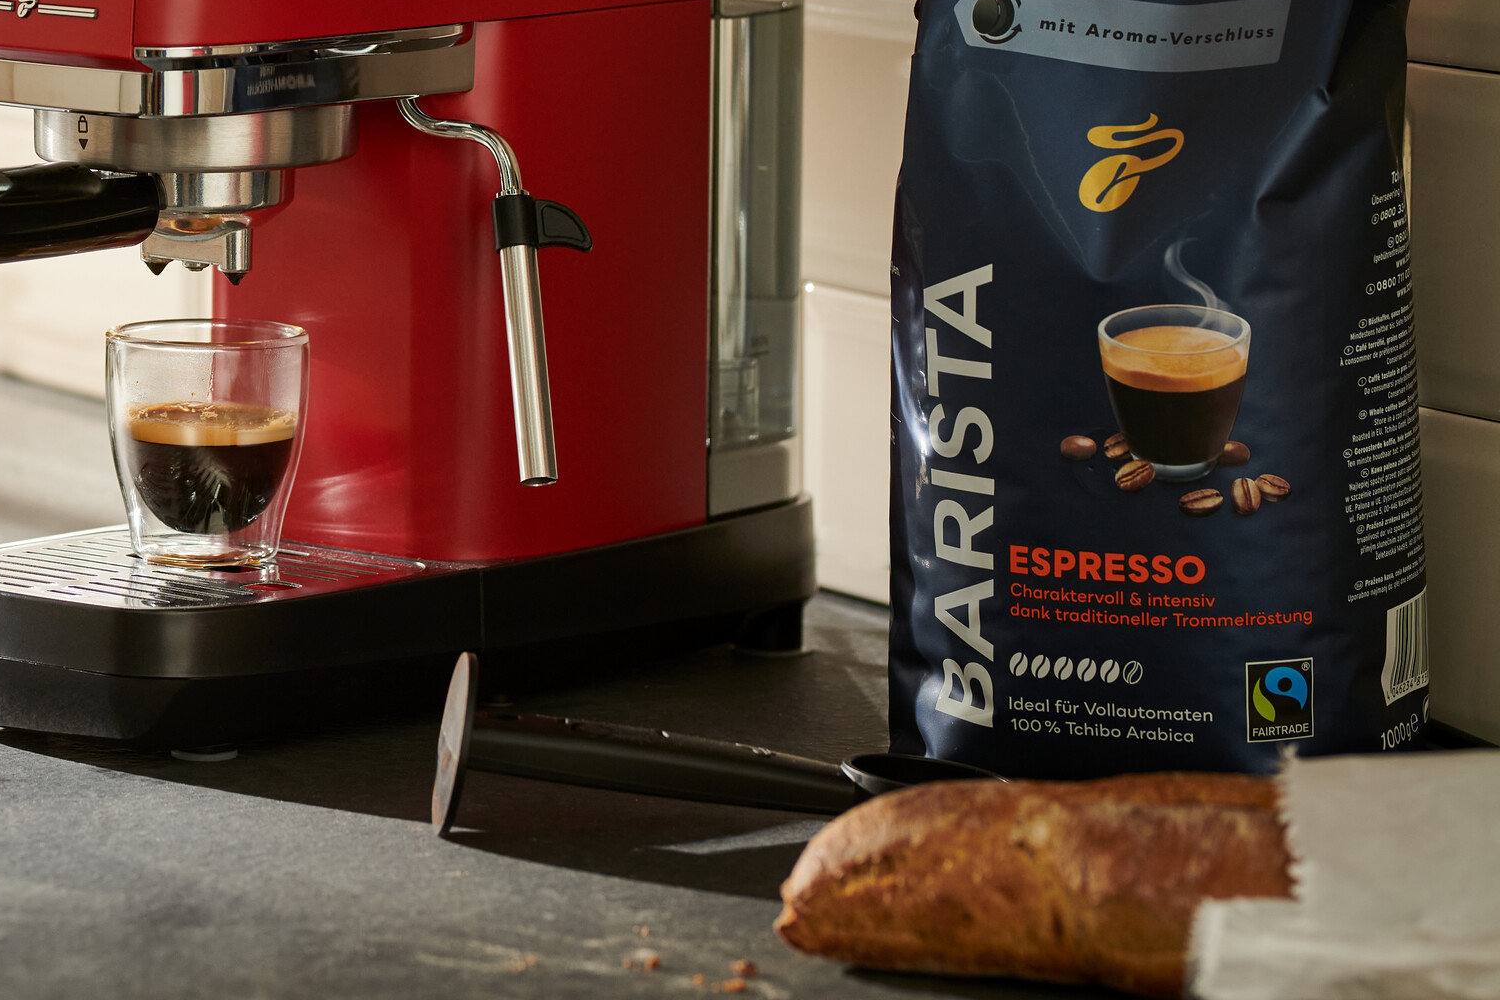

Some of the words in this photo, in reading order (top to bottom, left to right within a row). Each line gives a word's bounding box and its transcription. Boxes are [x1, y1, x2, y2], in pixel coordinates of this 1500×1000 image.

[1039, 18, 1076, 34] mit
[1085, 22, 1275, 46] Aroma-Verschluss
[1380, 207, 1396, 221] 0800
[1376, 277, 1396, 292] 0800
[1350, 329, 1376, 341] Mindestens
[1355, 344, 1367, 353] Café
[1345, 354, 1372, 366] consommer
[1372, 349, 1379, 359] de
[1368, 374, 1380, 384] Caffè
[1381, 370, 1397, 380] tostato
[1364, 388, 1371, 396] Da
[1369, 407, 1384, 417] Whole
[1385, 403, 1398, 413] coffee
[1374, 417, 1387, 426] Store
[1352, 431, 1371, 443] Roasted
[1354, 442, 1383, 456] Geroosterde
[1347, 459, 1356, 468] Ten
[1371, 465, 1383, 475] Kawa
[924, 264, 994, 728] BARISTA
[1355, 501, 1370, 512] Palona
[1356, 509, 1378, 521] Fabryczna
[1009, 544, 1206, 585] ESPRESSO
[1010, 582, 1124, 605] Charaktervoll
[1129, 591, 1142, 606] &
[1148, 592, 1215, 607] intensiv
[1347, 591, 1370, 603] Uporabno
[1010, 602, 1050, 620] dank
[1055, 608, 1168, 627] traditioneller
[1172, 610, 1313, 627] Trommelröstung
[1009, 696, 1050, 713] Ideal
[1055, 700, 1080, 715] für
[1084, 702, 1213, 722] Vollautomaten
[1065, 721, 1121, 738] Tchibo
[1126, 726, 1194, 743] Arabica
[1252, 722, 1309, 737] FAIRTRADE
